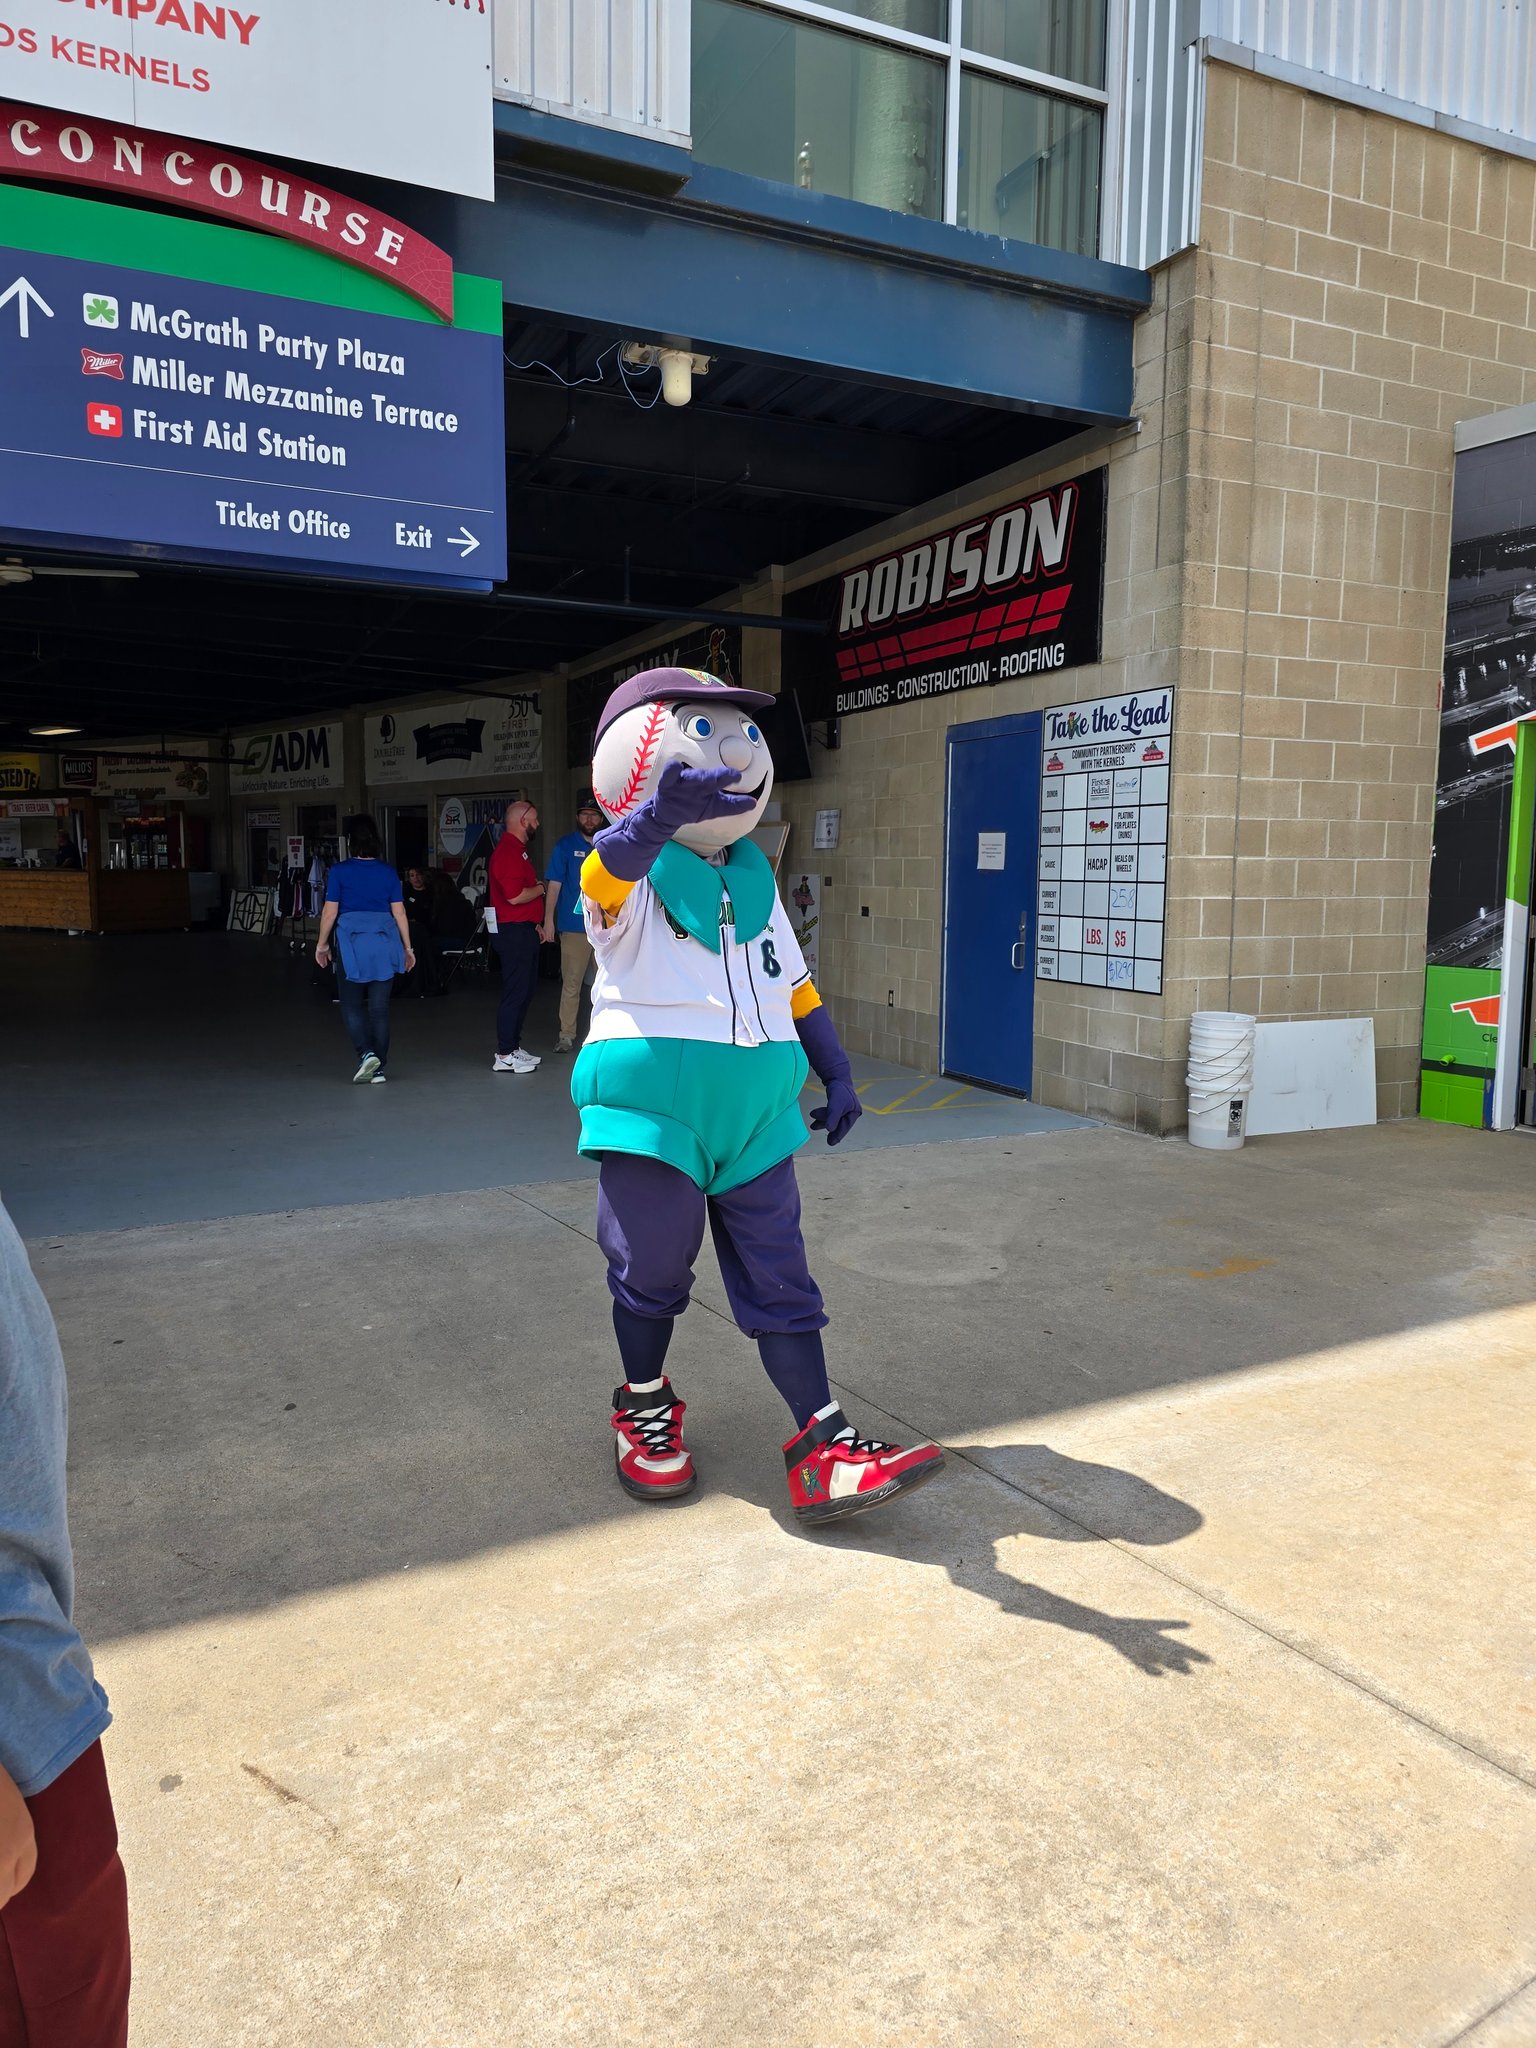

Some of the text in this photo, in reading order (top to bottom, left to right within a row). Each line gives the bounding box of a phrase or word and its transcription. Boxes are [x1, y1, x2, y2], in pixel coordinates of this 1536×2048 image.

[51, 35, 211, 93] KERNELS
[9, 118, 405, 267] CONCOURSE
[130, 301, 406, 376] McGrath Party Plaza
[86, 355, 119, 369] Miller
[132, 355, 459, 433] Miller Mezzanine Terrace
[133, 408, 347, 467] First Aid Station
[215, 500, 433, 549] Ticket Office Exit
[839, 488, 1073, 633] ROBISON
[837, 643, 1065, 713] BUILDINGS CONSTRUCTION ROOFING
[1046, 695, 1170, 741] Take the Lead
[271, 726, 330, 773] ADM
[1072, 747, 1099, 759] COMMUNITY
[1100, 743, 1136, 757] PARTNERSHIPS
[65, 761, 92, 774] MILIO'S
[1081, 756, 1125, 770] WITH THE KERNELS
[1091, 778, 1103, 787] First
[1046, 789, 1058, 798] DONOR
[1091, 786, 1109, 795] Federal
[1118, 811, 1134, 820] PLATING
[1042, 826, 1061, 834] PROMOTION
[1122, 821, 1137, 829] PLATES
[1118, 831, 1132, 839] (RUNS)
[1045, 860, 1056, 869] CAUSE
[1087, 858, 1108, 871] HACAP
[1115, 854, 1134, 863] MEALS ON
[1116, 864, 1132, 873] WHEELS
[1042, 890, 1056, 898] CURRENT
[1111, 888, 1135, 909] 258
[1041, 924, 1054, 932] AMOUNT
[1041, 934, 1055, 943] PLEDGED
[1086, 928, 1103, 945] LBS.
[1114, 929, 1126, 948] $5
[1040, 956, 1054, 965] CURRENT
[1042, 967, 1052, 976] TOTAL
